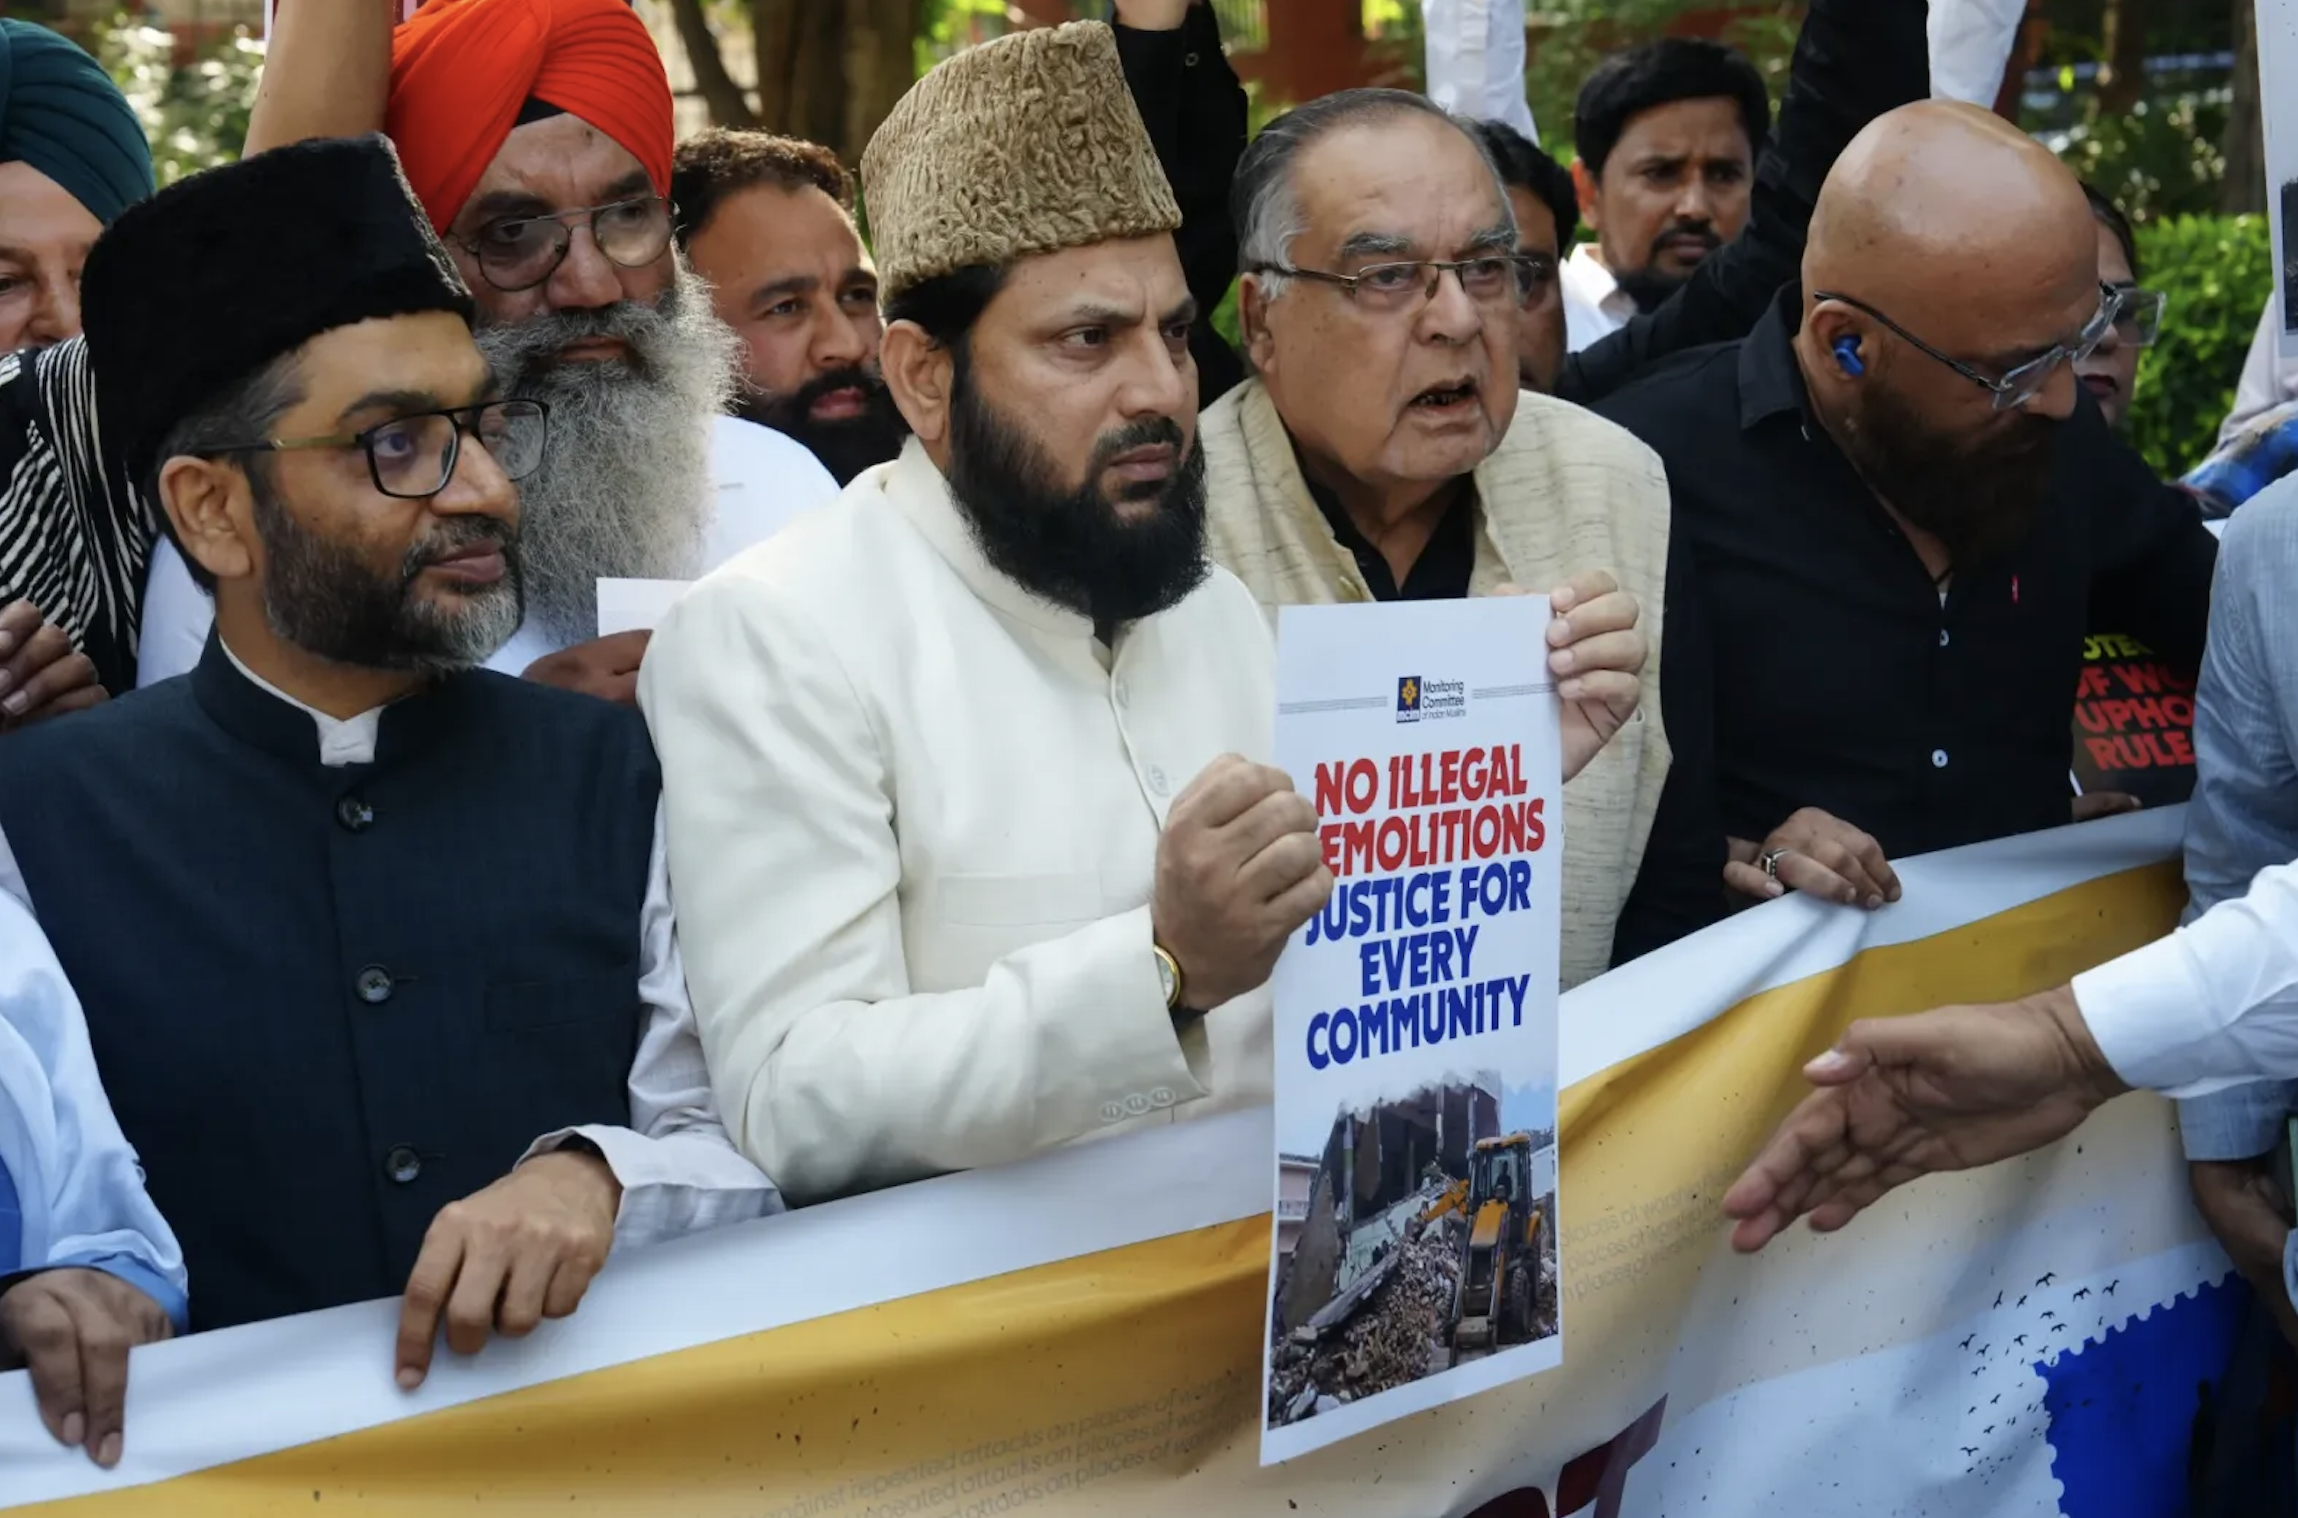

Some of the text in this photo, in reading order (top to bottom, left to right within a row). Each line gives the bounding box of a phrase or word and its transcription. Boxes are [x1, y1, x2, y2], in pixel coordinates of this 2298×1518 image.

[1422, 694, 1464, 709] Committee
[1423, 679, 1464, 695] Monitoring
[1314, 744, 1528, 817] NO ILLEGAL
[2084, 731, 2196, 770] RULE
[1318, 798, 1546, 878] EMOLITIONS
[1305, 860, 1532, 946] JUSTICE FOR
[1359, 924, 1480, 997] EVERY
[1305, 974, 1532, 1070] COMMUNITY
[850, 1450, 956, 1500] repeated
[960, 1430, 1044, 1466] attacks
[1154, 1387, 1179, 1412] of
[960, 1454, 1044, 1495] attacks
[1076, 1426, 1152, 1463] places
[1076, 1449, 1145, 1490] places
[1150, 1437, 1172, 1462] of
